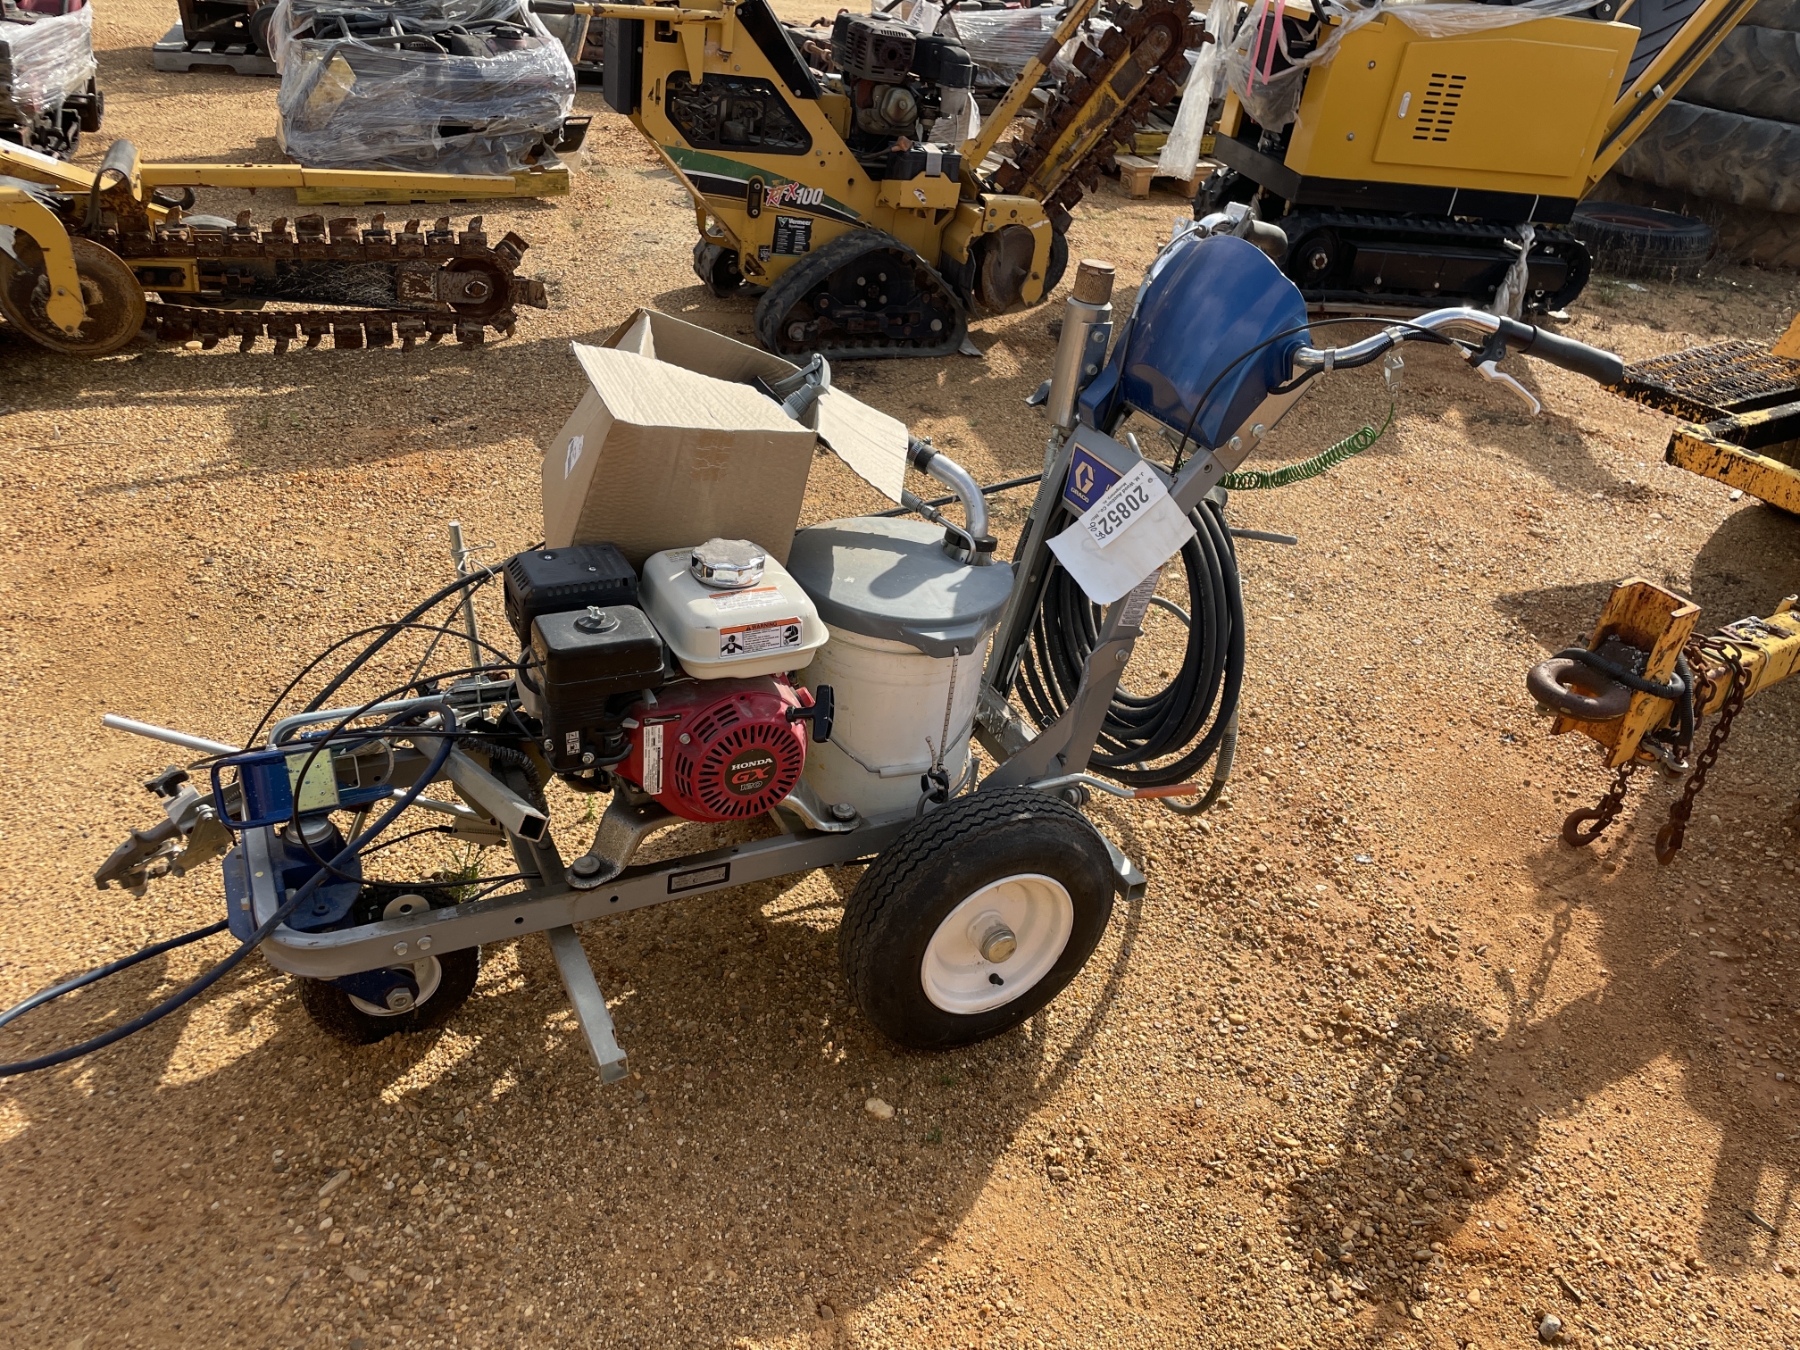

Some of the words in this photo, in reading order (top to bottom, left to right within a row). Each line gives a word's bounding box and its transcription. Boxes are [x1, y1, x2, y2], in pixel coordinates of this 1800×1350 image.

[1070, 486, 1090, 503] GRACO
[1098, 485, 1149, 536] 20852
[751, 621, 778, 631] WARNING
[731, 757, 774, 771] HONDA
[731, 766, 772, 785] GX
